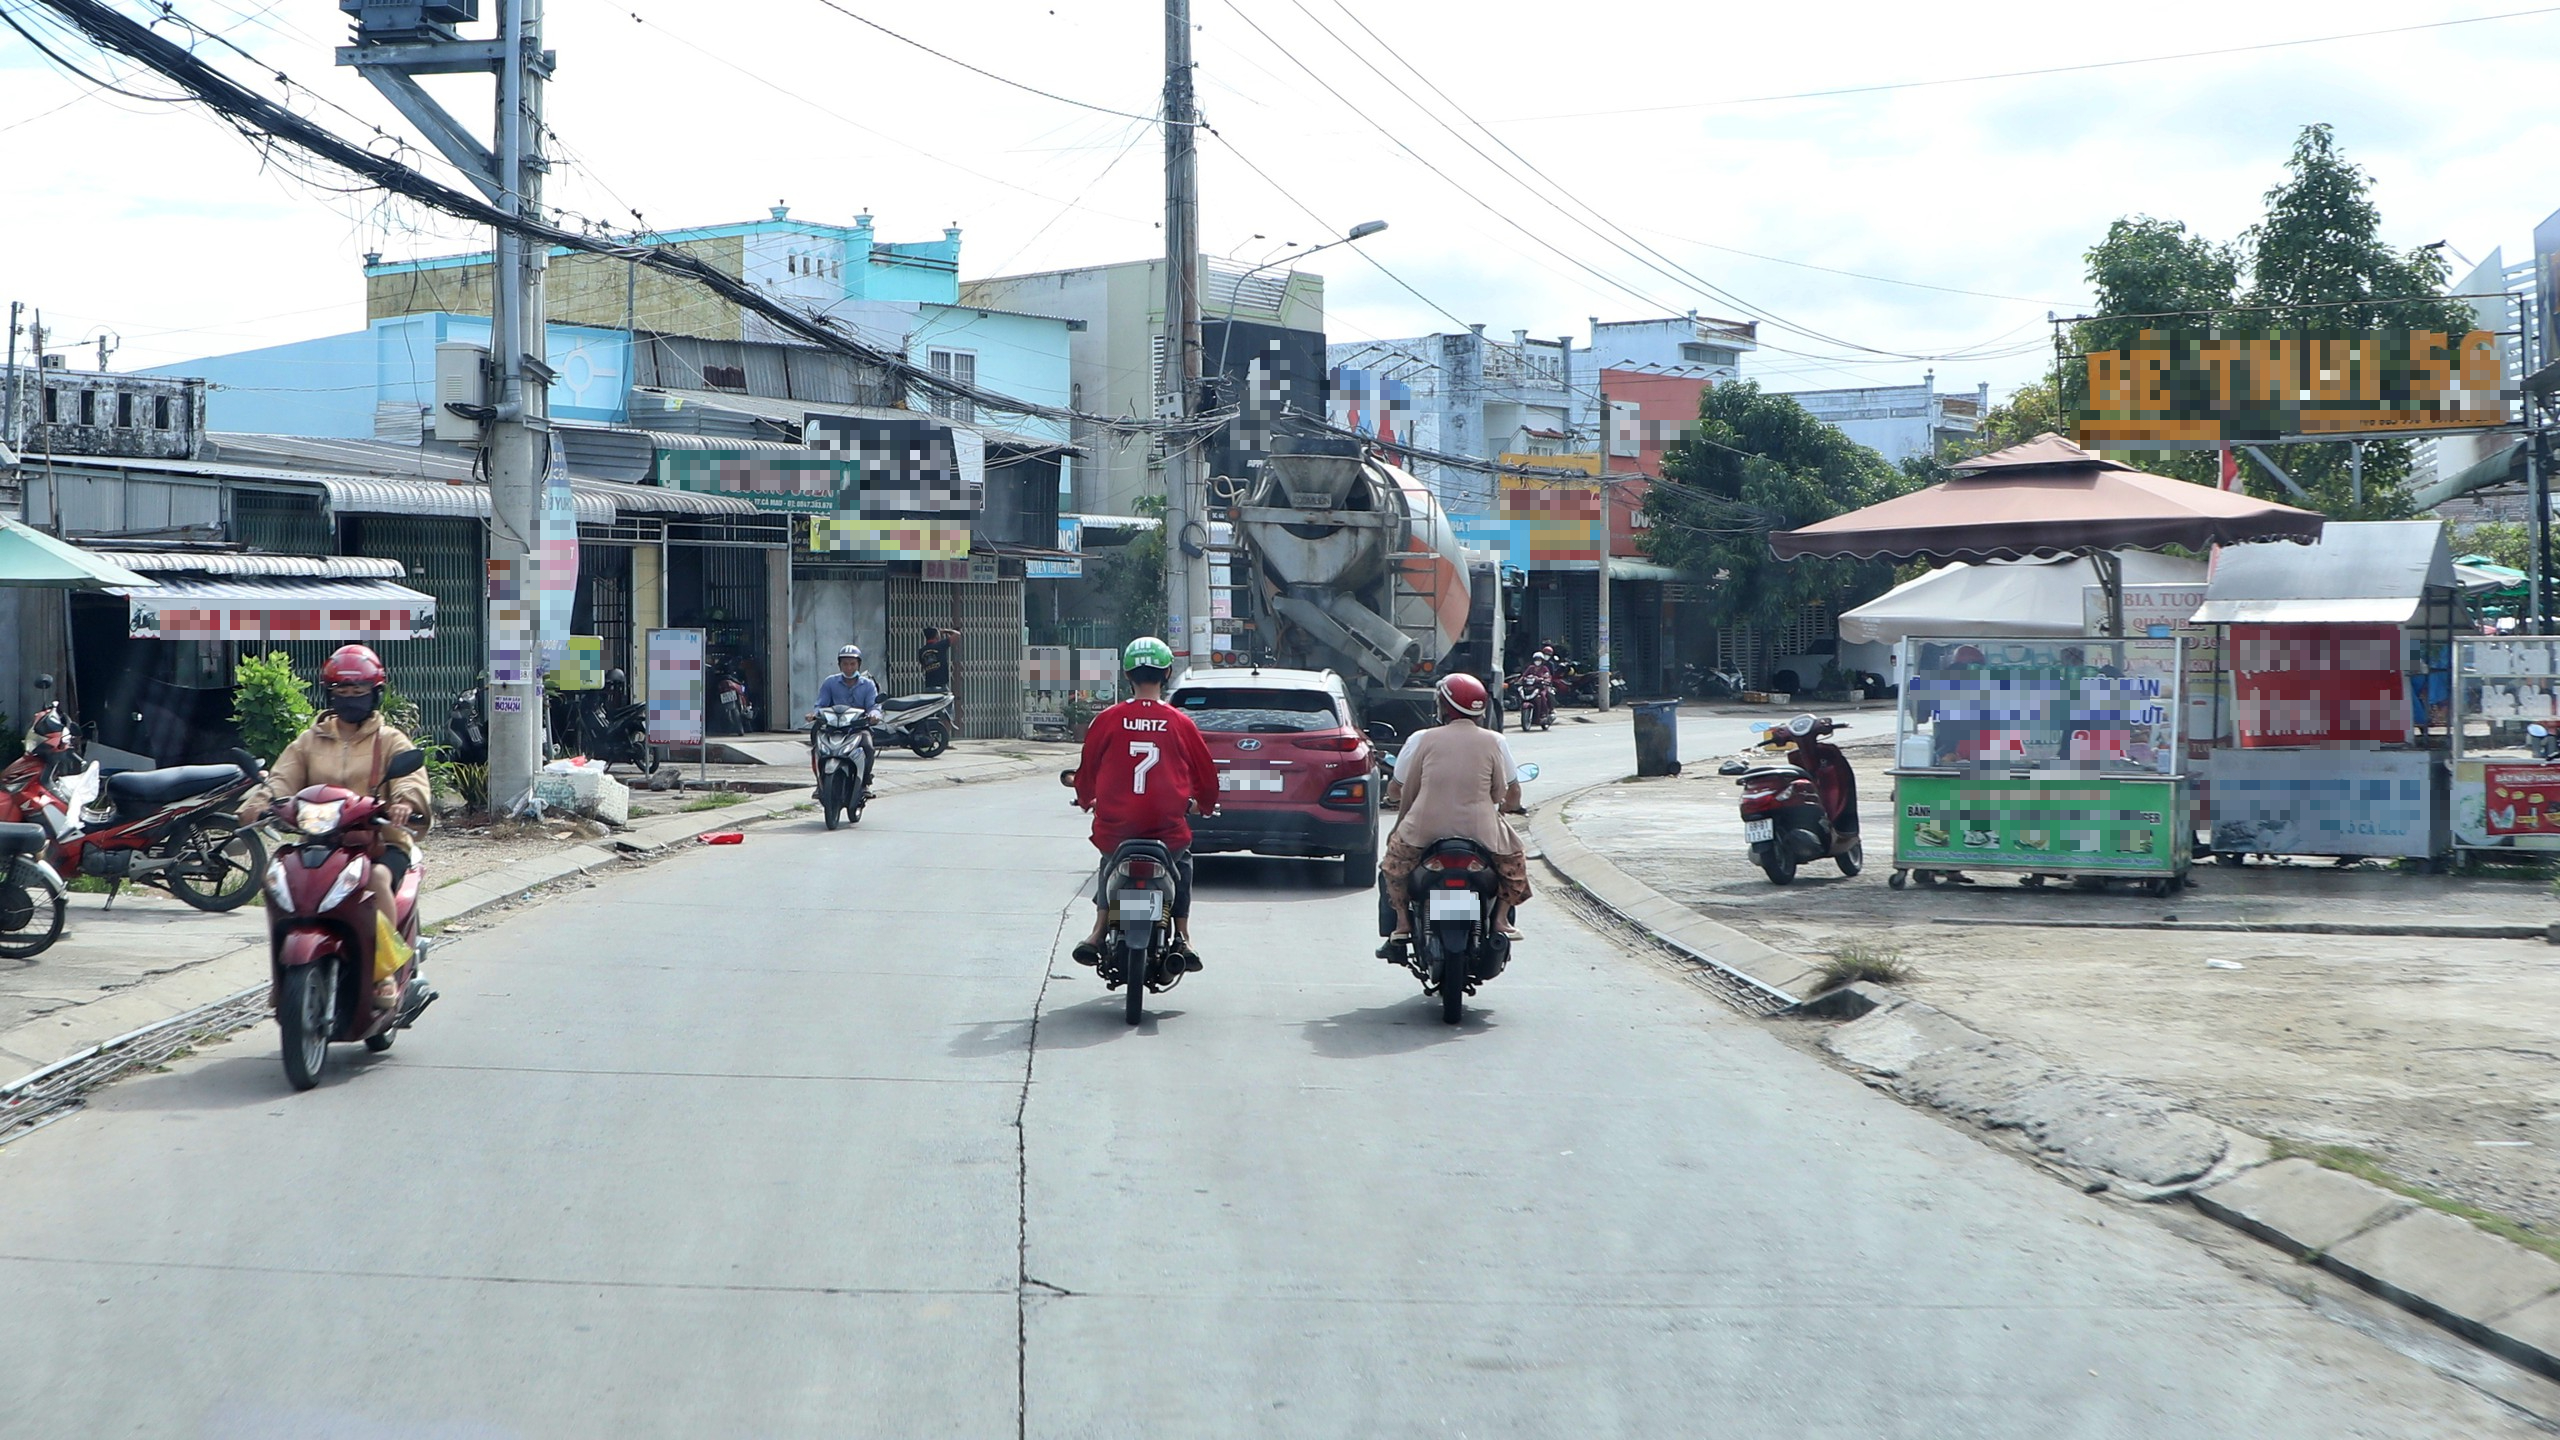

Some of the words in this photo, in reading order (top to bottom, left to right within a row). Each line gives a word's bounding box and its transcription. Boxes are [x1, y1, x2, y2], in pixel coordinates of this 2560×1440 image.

[2123, 593, 2154, 606] BIA
[1123, 717, 1168, 732] WIRTZ
[1129, 740, 1160, 795] 7
